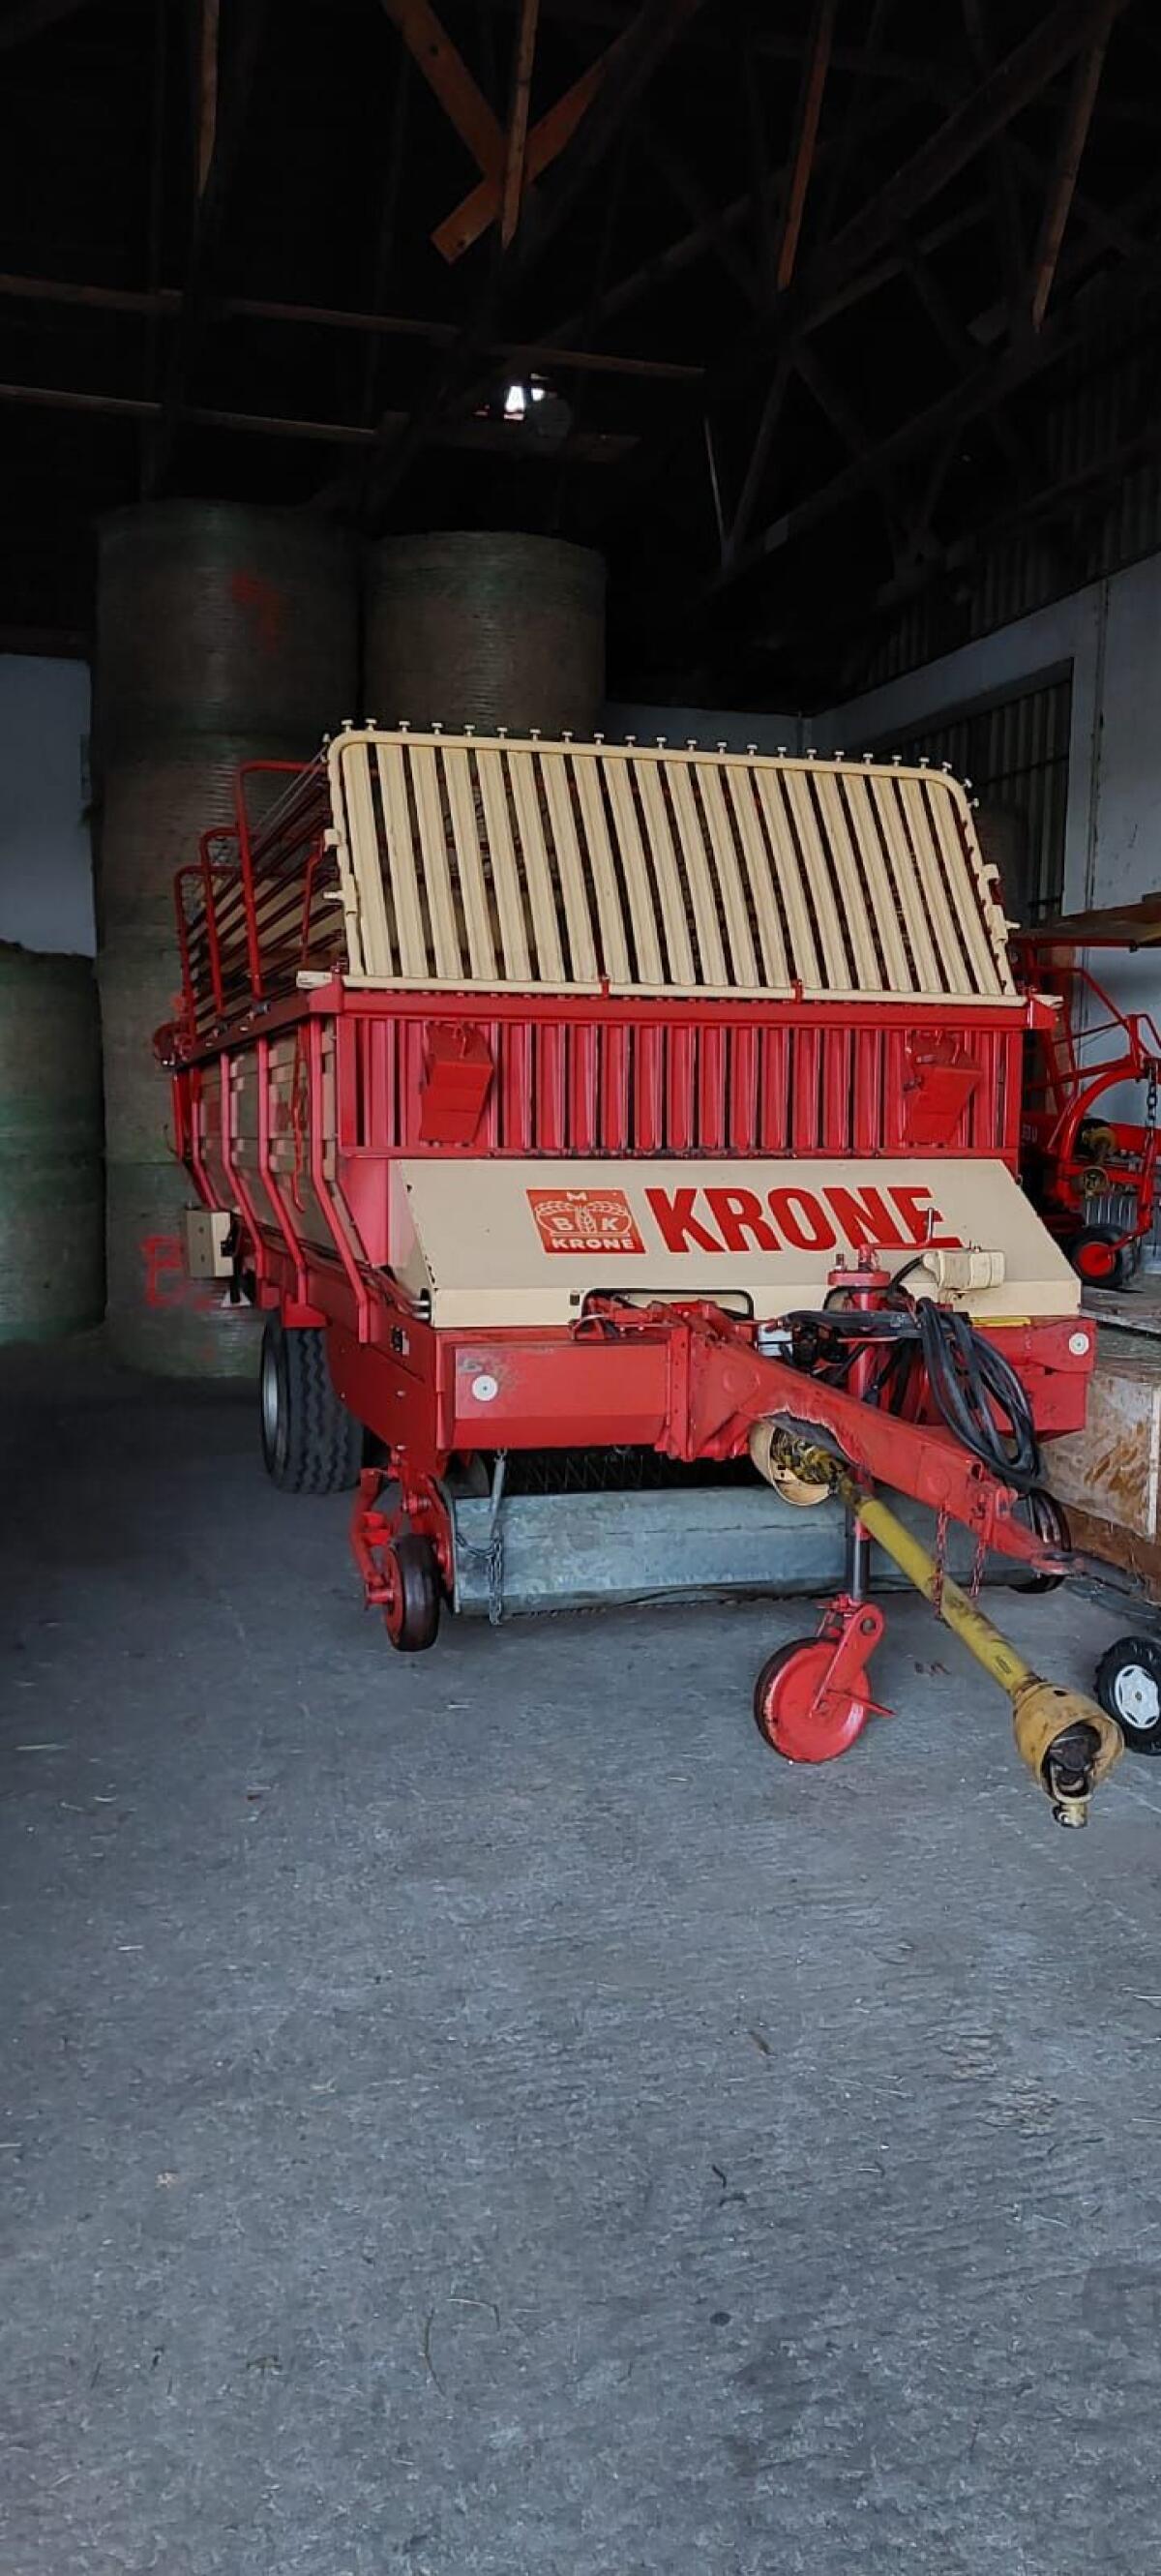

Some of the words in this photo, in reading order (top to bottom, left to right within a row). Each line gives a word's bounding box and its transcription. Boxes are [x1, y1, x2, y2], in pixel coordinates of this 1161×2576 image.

[551, 1217, 575, 1231] B
[601, 1217, 620, 1231] K
[644, 1187, 963, 1253] KRONE
[551, 1238, 636, 1250] KRONE
